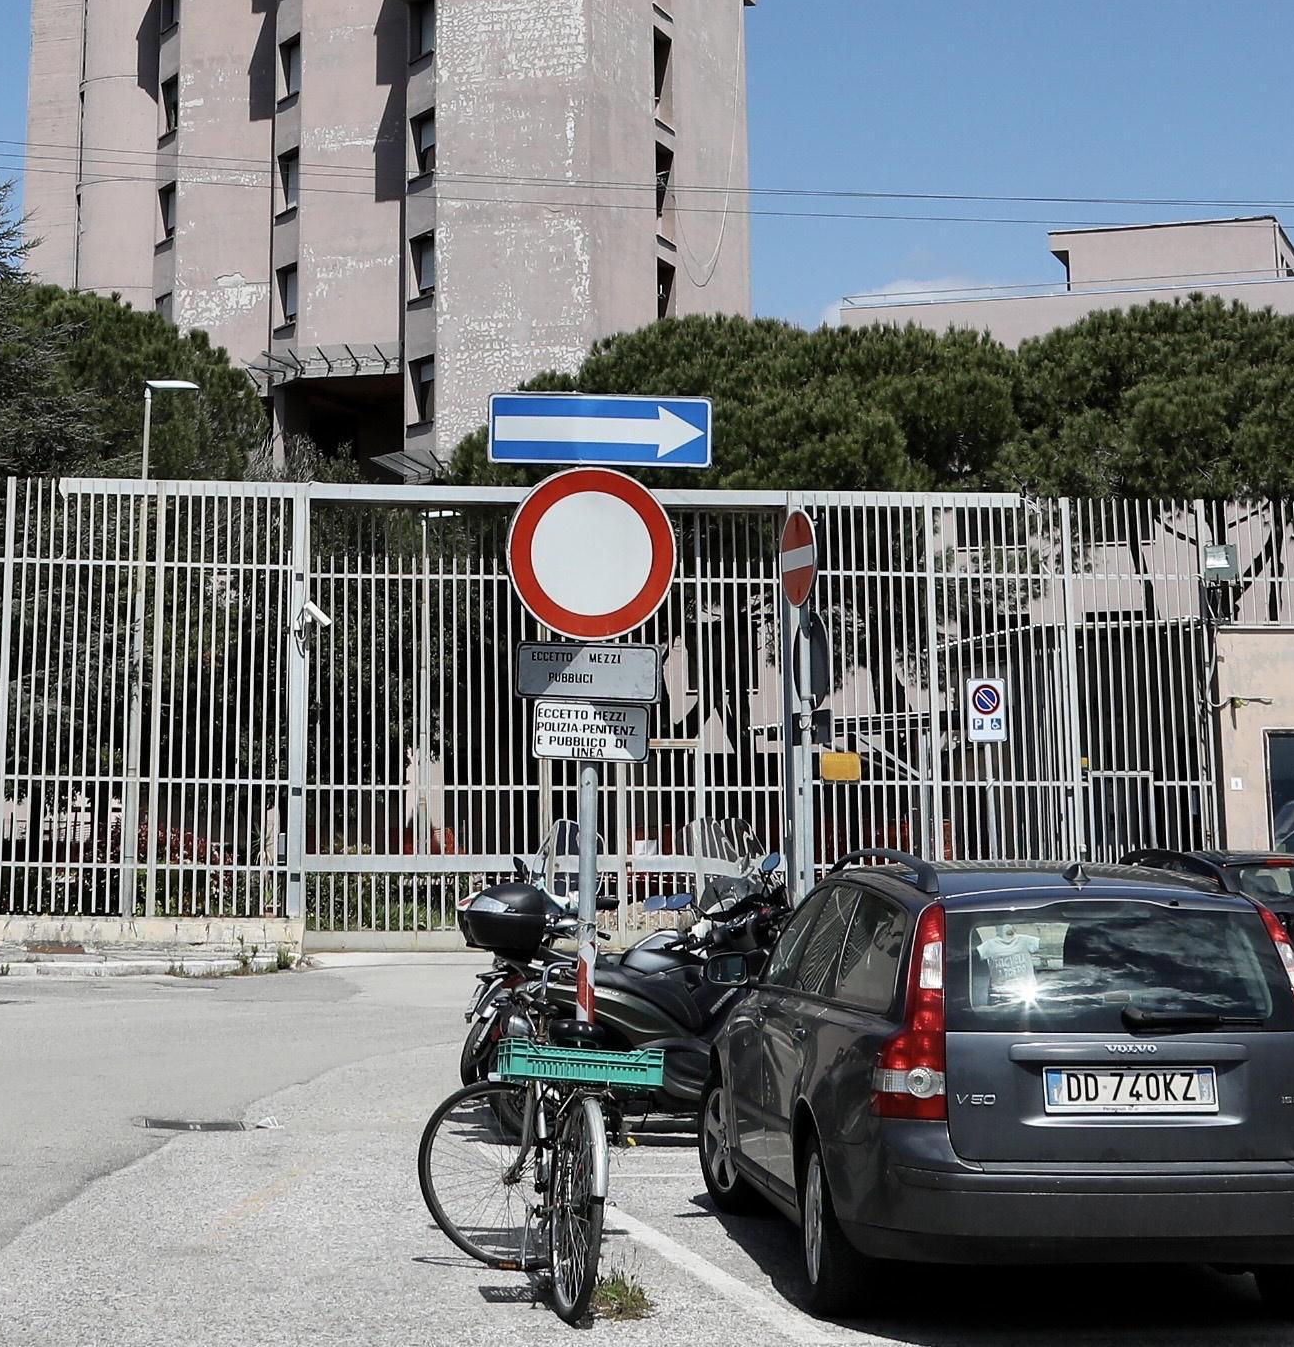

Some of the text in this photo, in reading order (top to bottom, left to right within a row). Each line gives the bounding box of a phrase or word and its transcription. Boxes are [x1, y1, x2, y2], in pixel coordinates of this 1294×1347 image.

[531, 651, 621, 664] ECCETTO MEZZI
[548, 672, 593, 684] PUBBLICI
[537, 708, 626, 722] ECCETTO MEZZI
[537, 735, 627, 749] E PUBBLICO DI
[571, 747, 604, 758] LINEA
[1104, 1043, 1158, 1053] VOLVO
[1066, 1072, 1196, 1101] DD 740KZ
